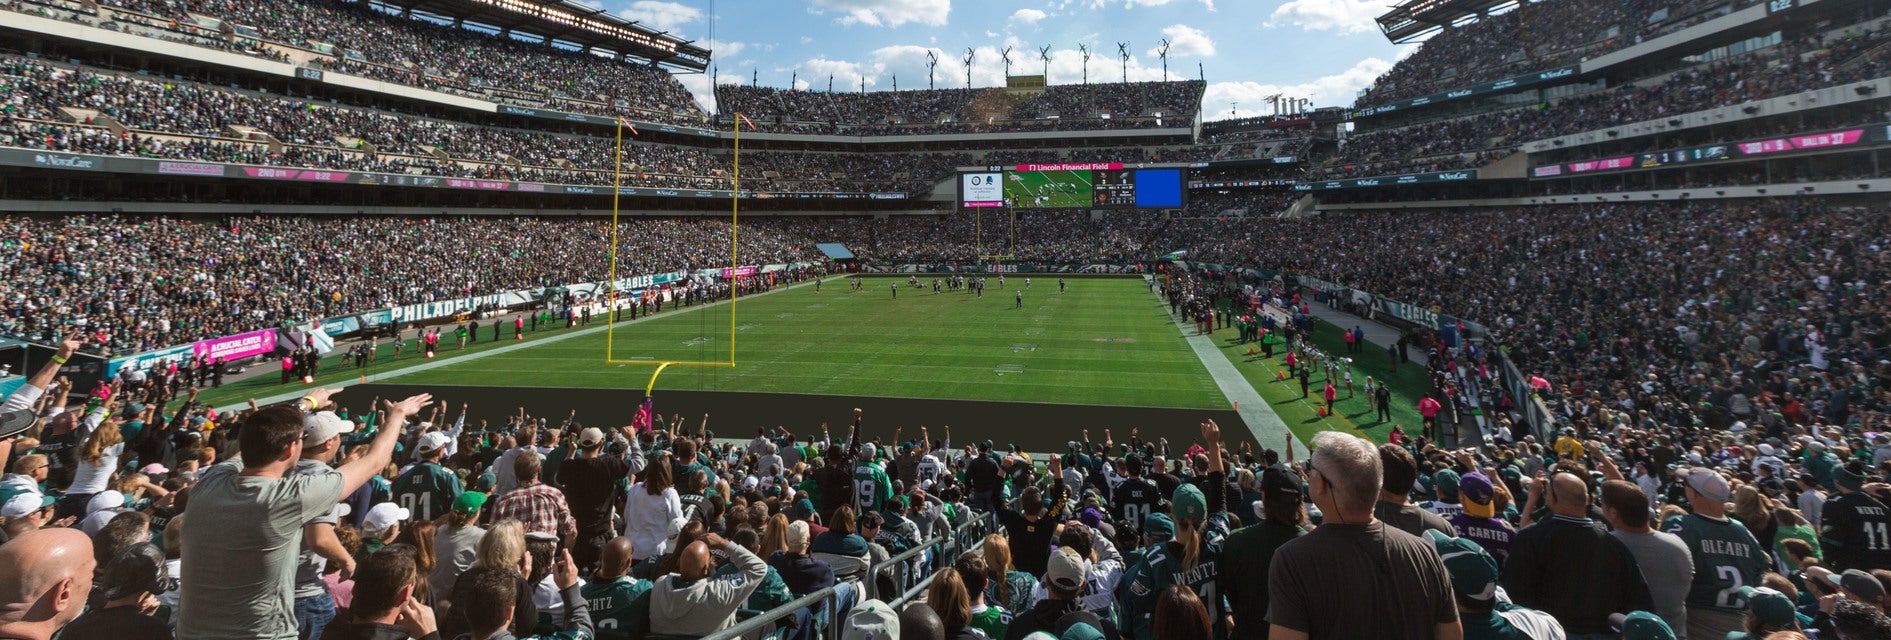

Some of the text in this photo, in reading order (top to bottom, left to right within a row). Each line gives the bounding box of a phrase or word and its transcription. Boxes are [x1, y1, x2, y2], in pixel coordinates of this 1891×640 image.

[303, 69, 320, 80] 0:22
[1802, 137, 1818, 147] BALL
[46, 154, 93, 168] NovaCare
[1062, 163, 1091, 171] Financial
[1092, 162, 1109, 170] Field
[258, 168, 275, 177] 2ND
[315, 172, 331, 181] 0:22
[987, 264, 1018, 273] EAGLES
[621, 274, 654, 290] EAGLES
[390, 293, 508, 322] PHILADELPHIA
[1400, 301, 1439, 331] EAGLES
[1123, 502, 1150, 530] 91
[1854, 505, 1885, 516] WENTZ
[1468, 525, 1510, 543] CARTER
[1863, 521, 1890, 550] 11
[1172, 560, 1218, 586] WENTZ
[1715, 564, 1746, 609] 2
